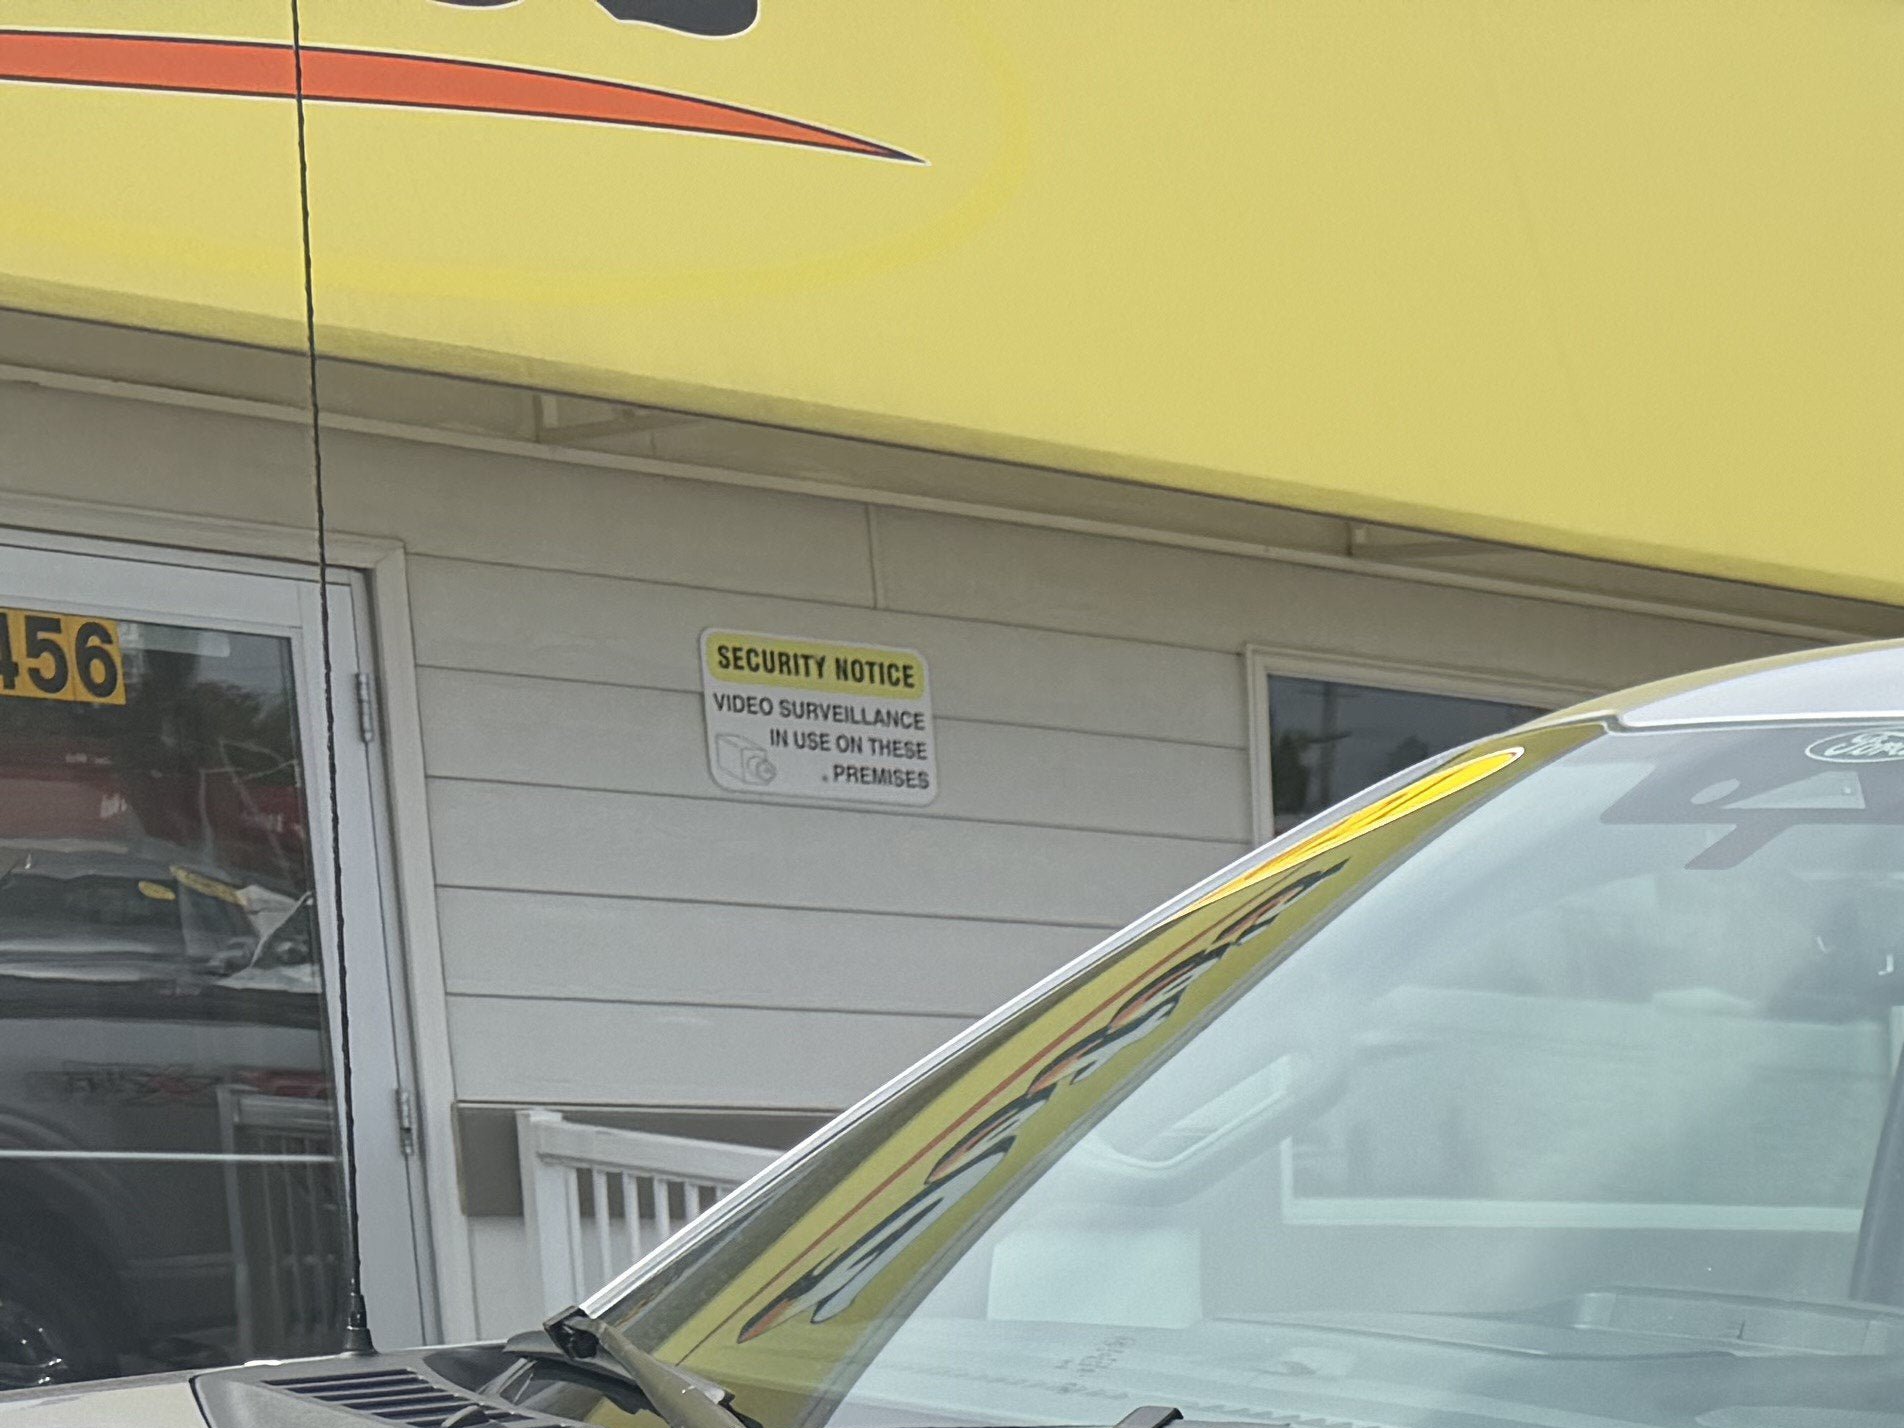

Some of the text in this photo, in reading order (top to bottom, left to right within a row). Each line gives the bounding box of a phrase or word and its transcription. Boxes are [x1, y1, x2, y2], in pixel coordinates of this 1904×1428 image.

[717, 645, 916, 689] SECURITY NOTICE
[713, 692, 926, 731] VIDEO SURVEILLANCE
[770, 728, 928, 760] IN USE ON THESE
[833, 763, 930, 789] PREMISES
